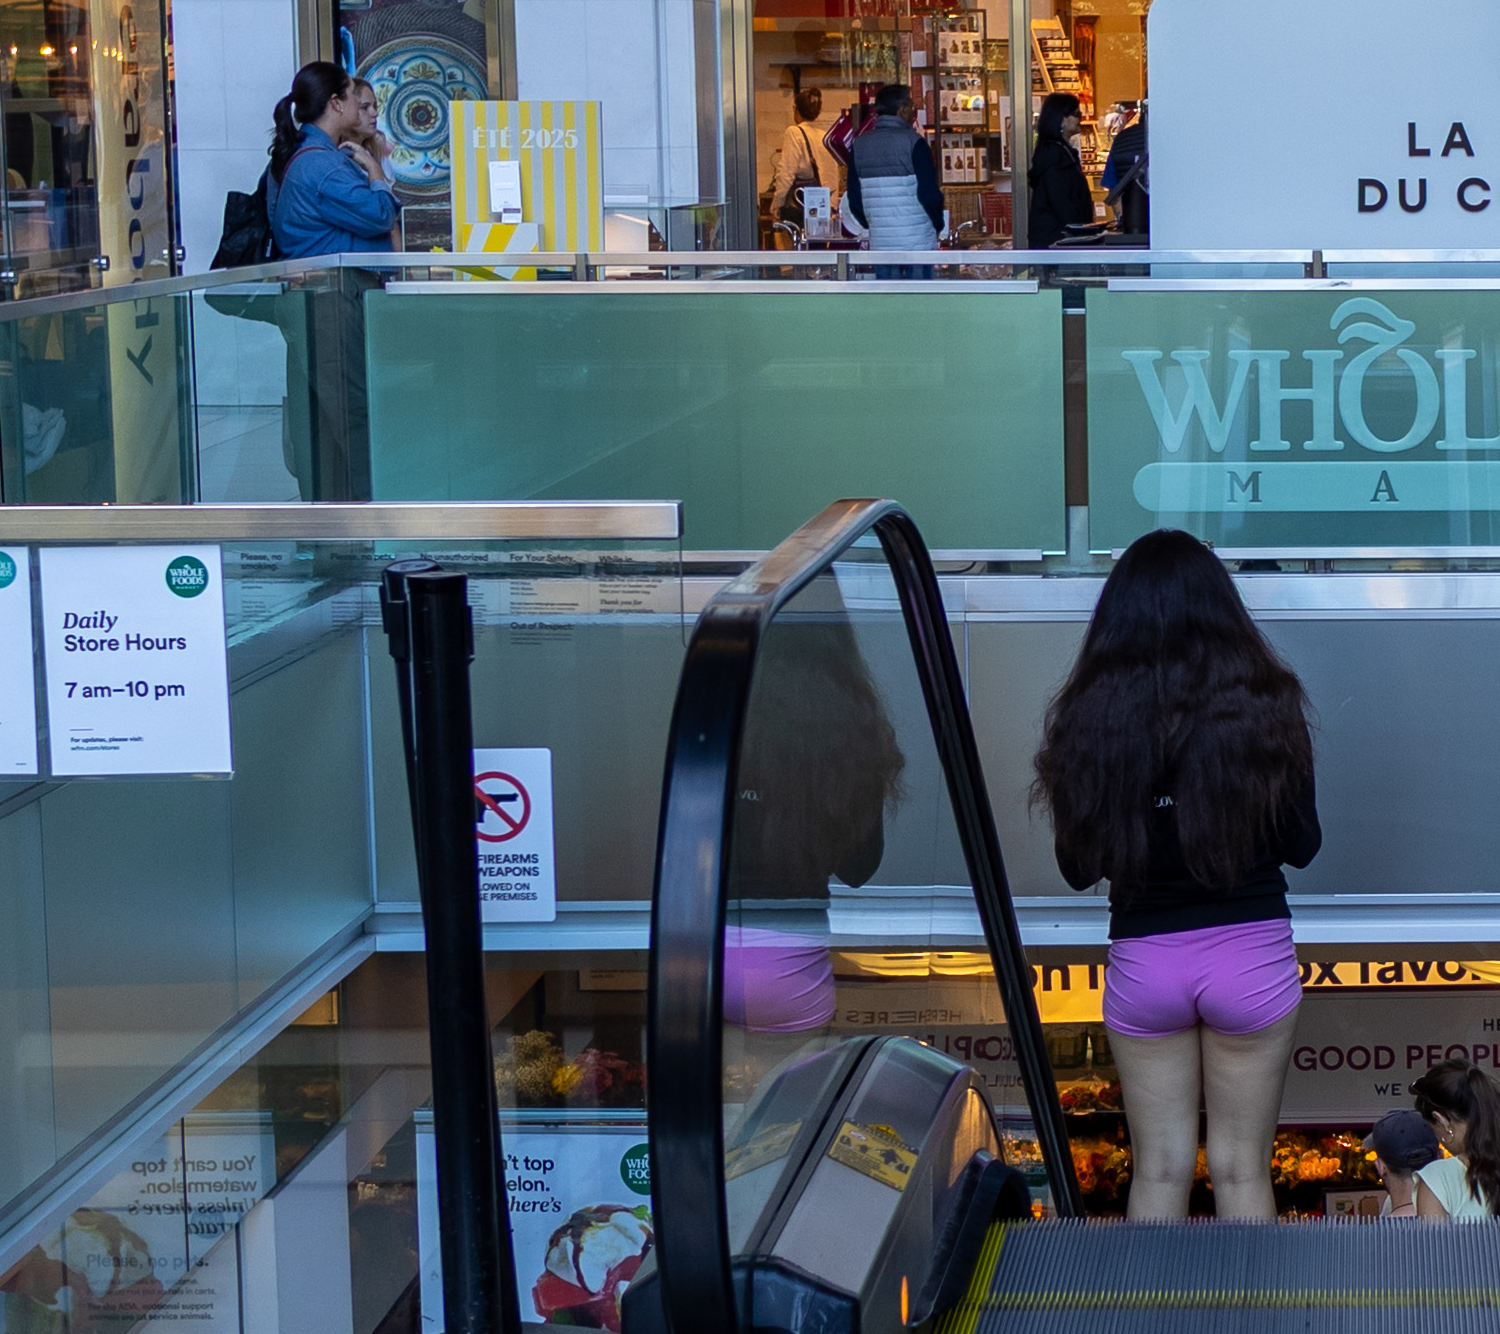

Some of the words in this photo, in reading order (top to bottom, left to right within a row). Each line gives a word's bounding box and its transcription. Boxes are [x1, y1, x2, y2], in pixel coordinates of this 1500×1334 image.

[472, 127, 513, 149] ÉTÉ
[520, 129, 579, 149] 2025
[1407, 121, 1475, 157] LA
[1357, 177, 1426, 213] DU
[169, 566, 204, 577] WHOLE
[172, 575, 205, 585] FOODS
[63, 611, 118, 633] Daily
[64, 634, 120, 652] Store
[126, 633, 187, 651] Hours
[64, 682, 78, 698] 7
[154, 682, 186, 701] pm
[477, 853, 539, 864] FIREARMS
[514, 882, 530, 891] ON
[490, 892, 538, 901] PREMISES
[1293, 1045, 1396, 1072] GOOD
[1374, 1082, 1401, 1097] WE
[523, 1155, 555, 1175] top
[508, 1196, 562, 1213] here’s
